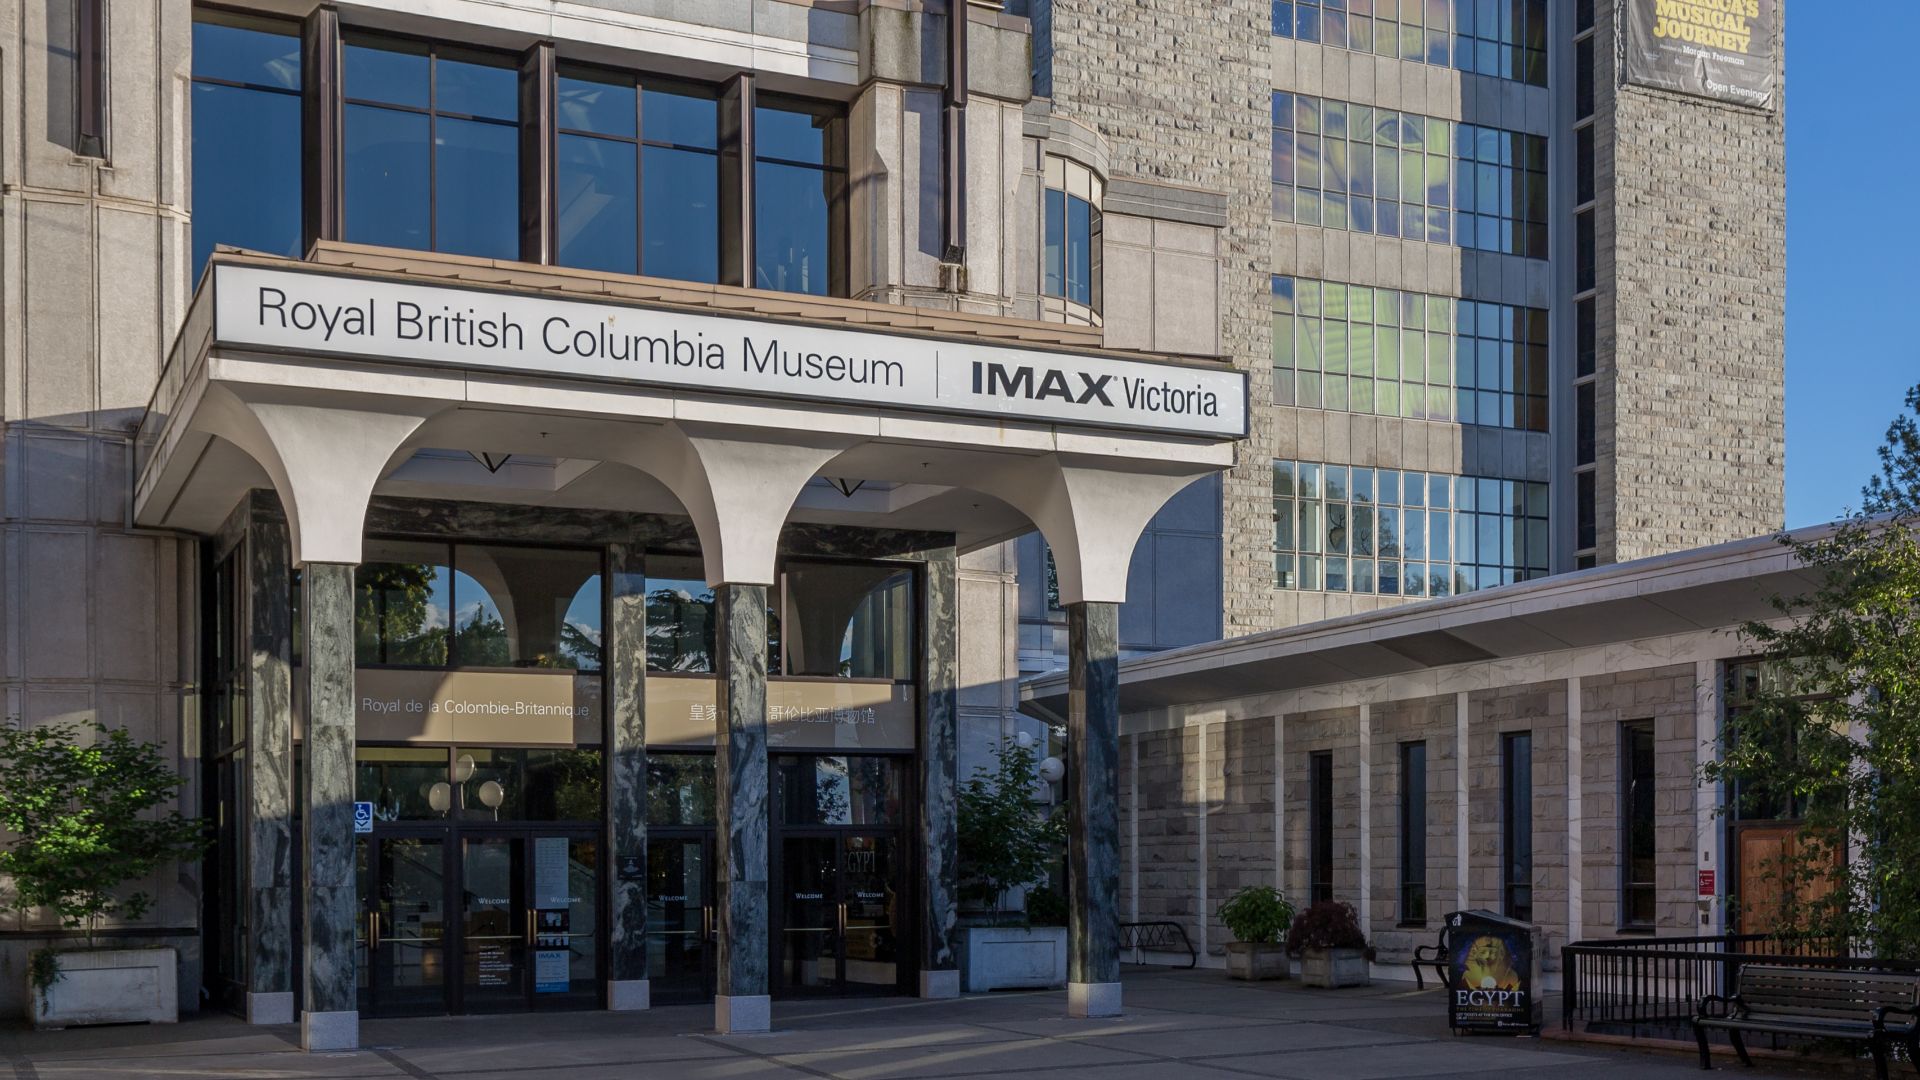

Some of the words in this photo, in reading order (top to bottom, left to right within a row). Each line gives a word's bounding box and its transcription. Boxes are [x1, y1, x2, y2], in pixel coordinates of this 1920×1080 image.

[1656, 1, 1751, 35] MUSICAL
[1653, 17, 1751, 54] JOURNEY
[1683, 45, 1711, 59] Morgan
[1712, 52, 1744, 66] Freeman
[1706, 79, 1728, 93] Open
[258, 286, 375, 341] Royal
[397, 301, 524, 351] British
[542, 316, 725, 370] Columbia
[742, 337, 904, 388] Museum
[1124, 379, 1218, 417] Victoria
[362, 697, 400, 714] Royal
[405, 699, 423, 713] de
[429, 699, 439, 713] la
[444, 700, 589, 719] Colombie-Britannique
[1456, 990, 1524, 1007] EGYPT
